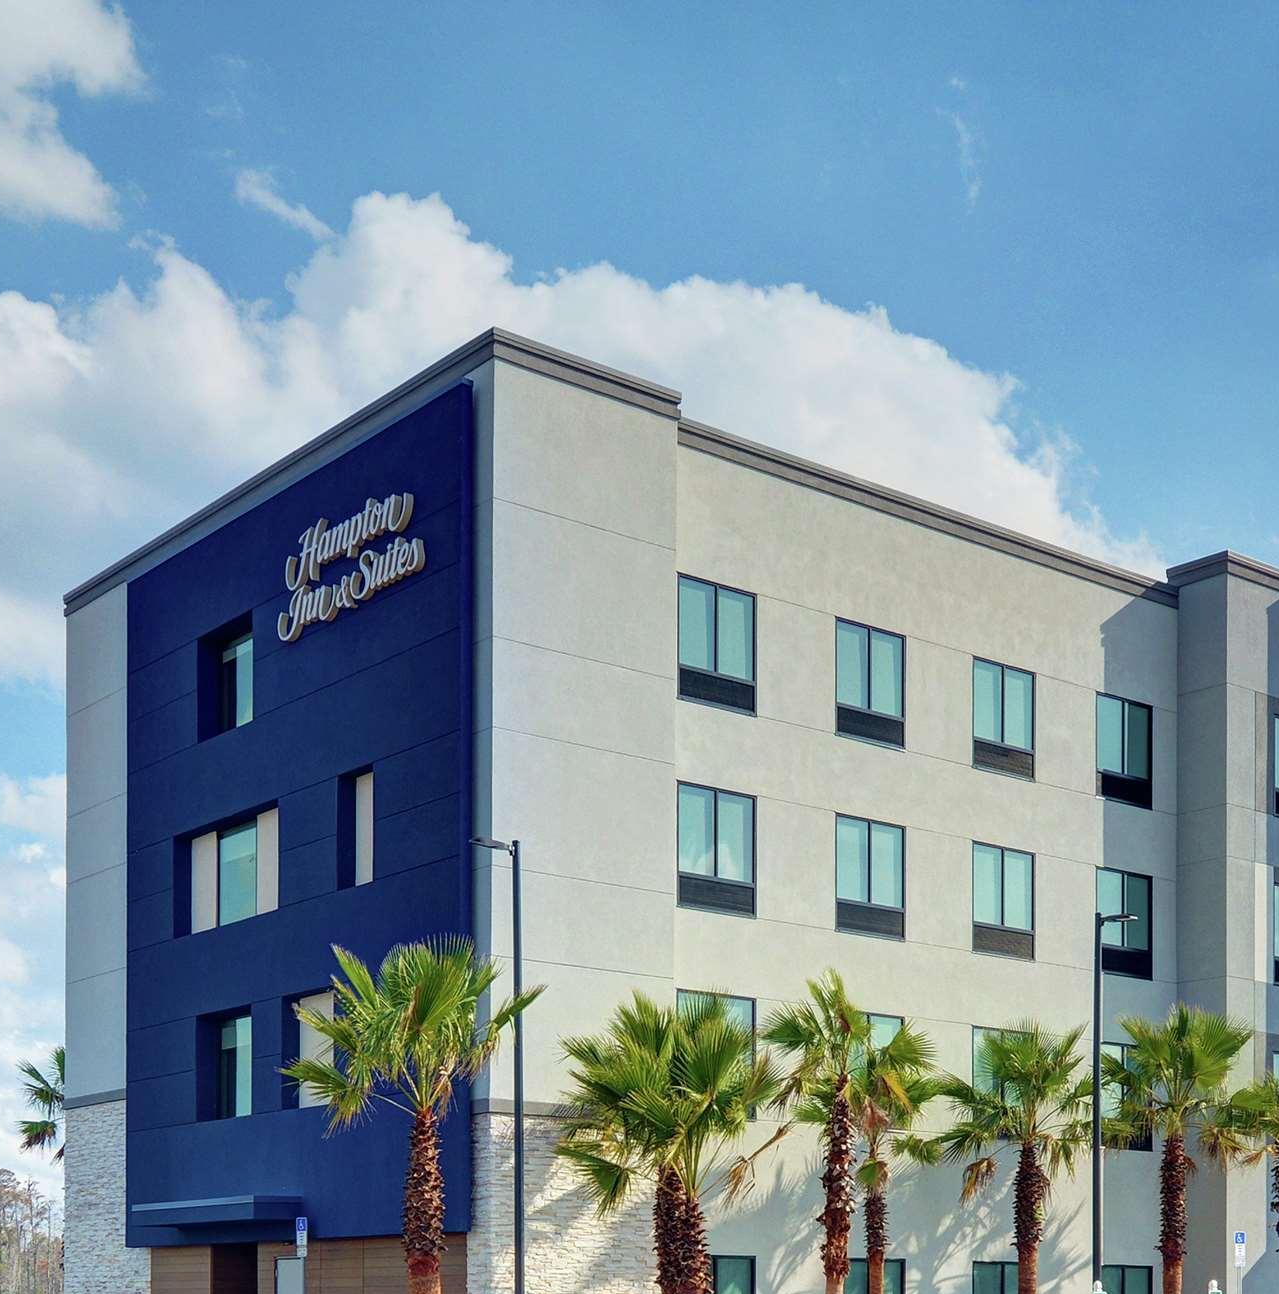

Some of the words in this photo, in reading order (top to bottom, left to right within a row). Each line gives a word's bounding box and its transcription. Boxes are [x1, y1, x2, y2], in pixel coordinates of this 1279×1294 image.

[277, 584, 340, 642] Inn
[336, 575, 358, 608] &
[350, 536, 426, 600] Suites
[285, 492, 414, 591] Hampton
